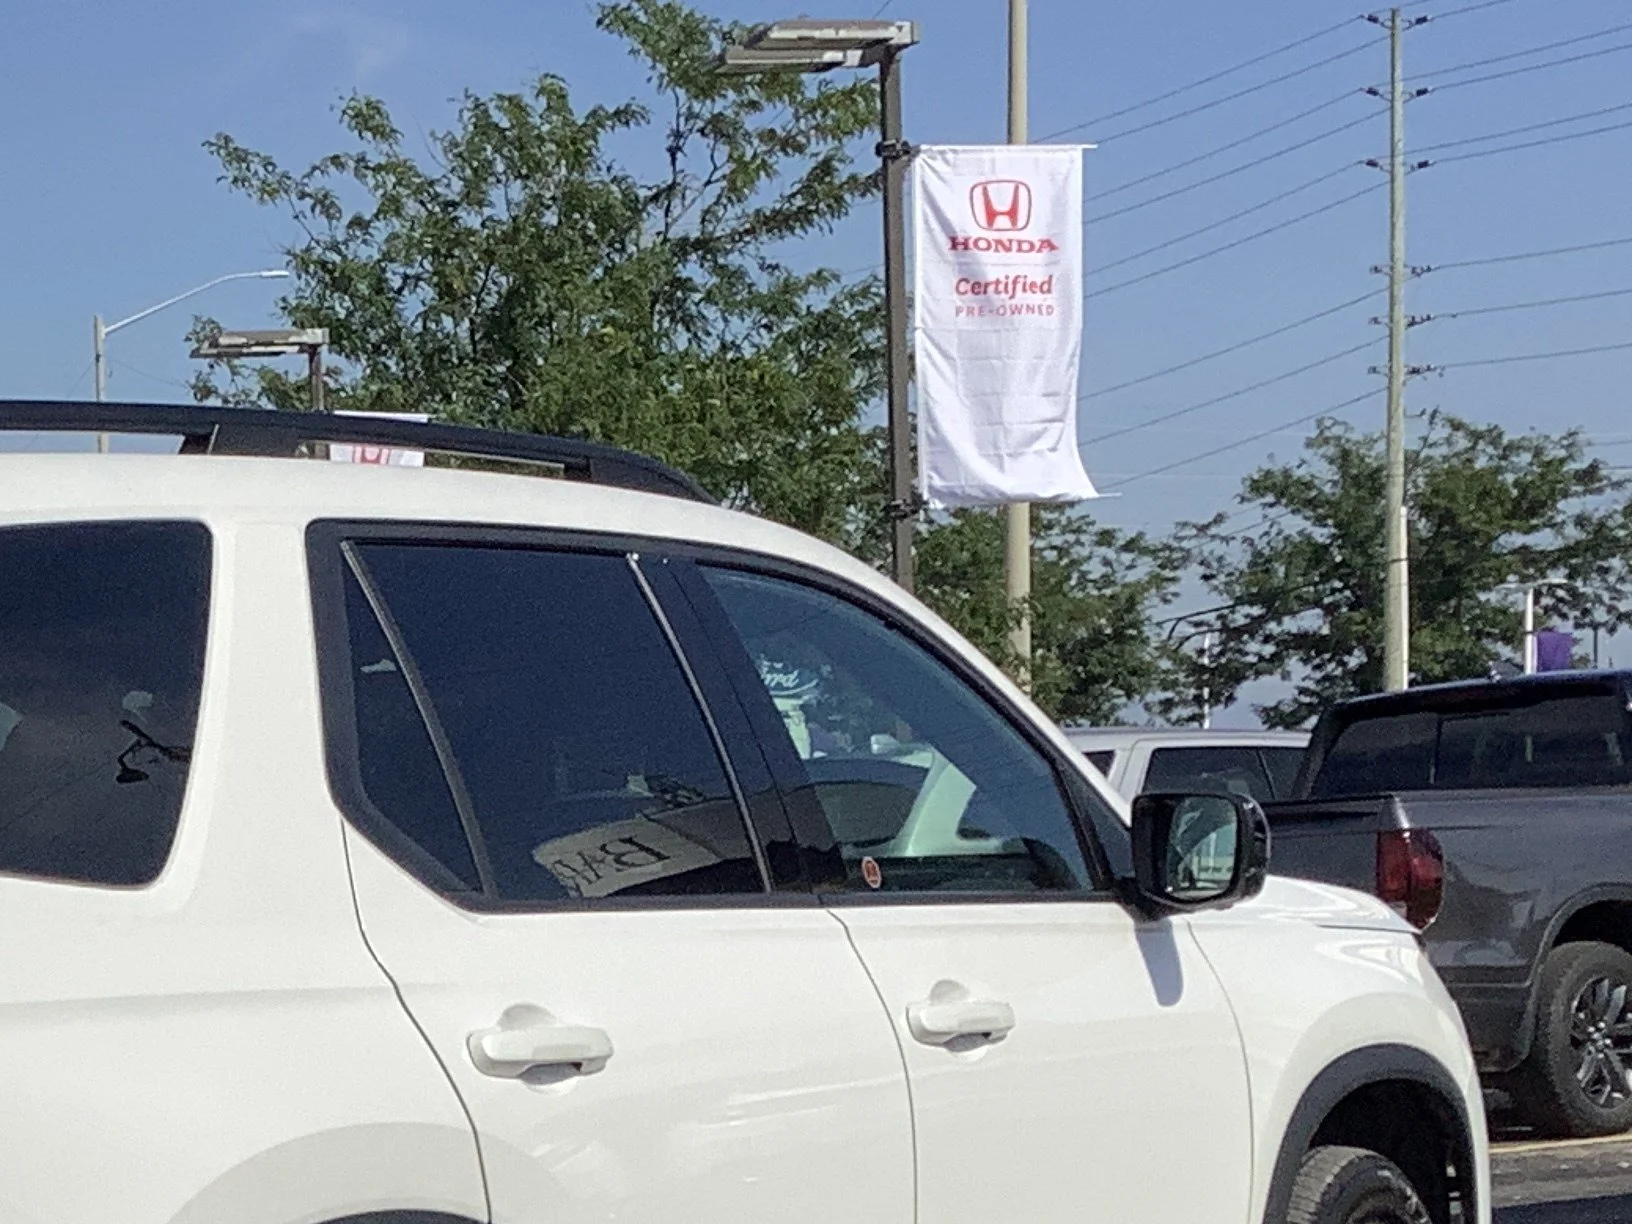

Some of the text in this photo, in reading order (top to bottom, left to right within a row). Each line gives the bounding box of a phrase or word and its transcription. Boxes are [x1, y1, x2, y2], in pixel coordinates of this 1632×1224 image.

[948, 236, 1059, 254] HONDA
[955, 274, 1053, 300] Certified
[955, 304, 1055, 317] PRE-OWNED
